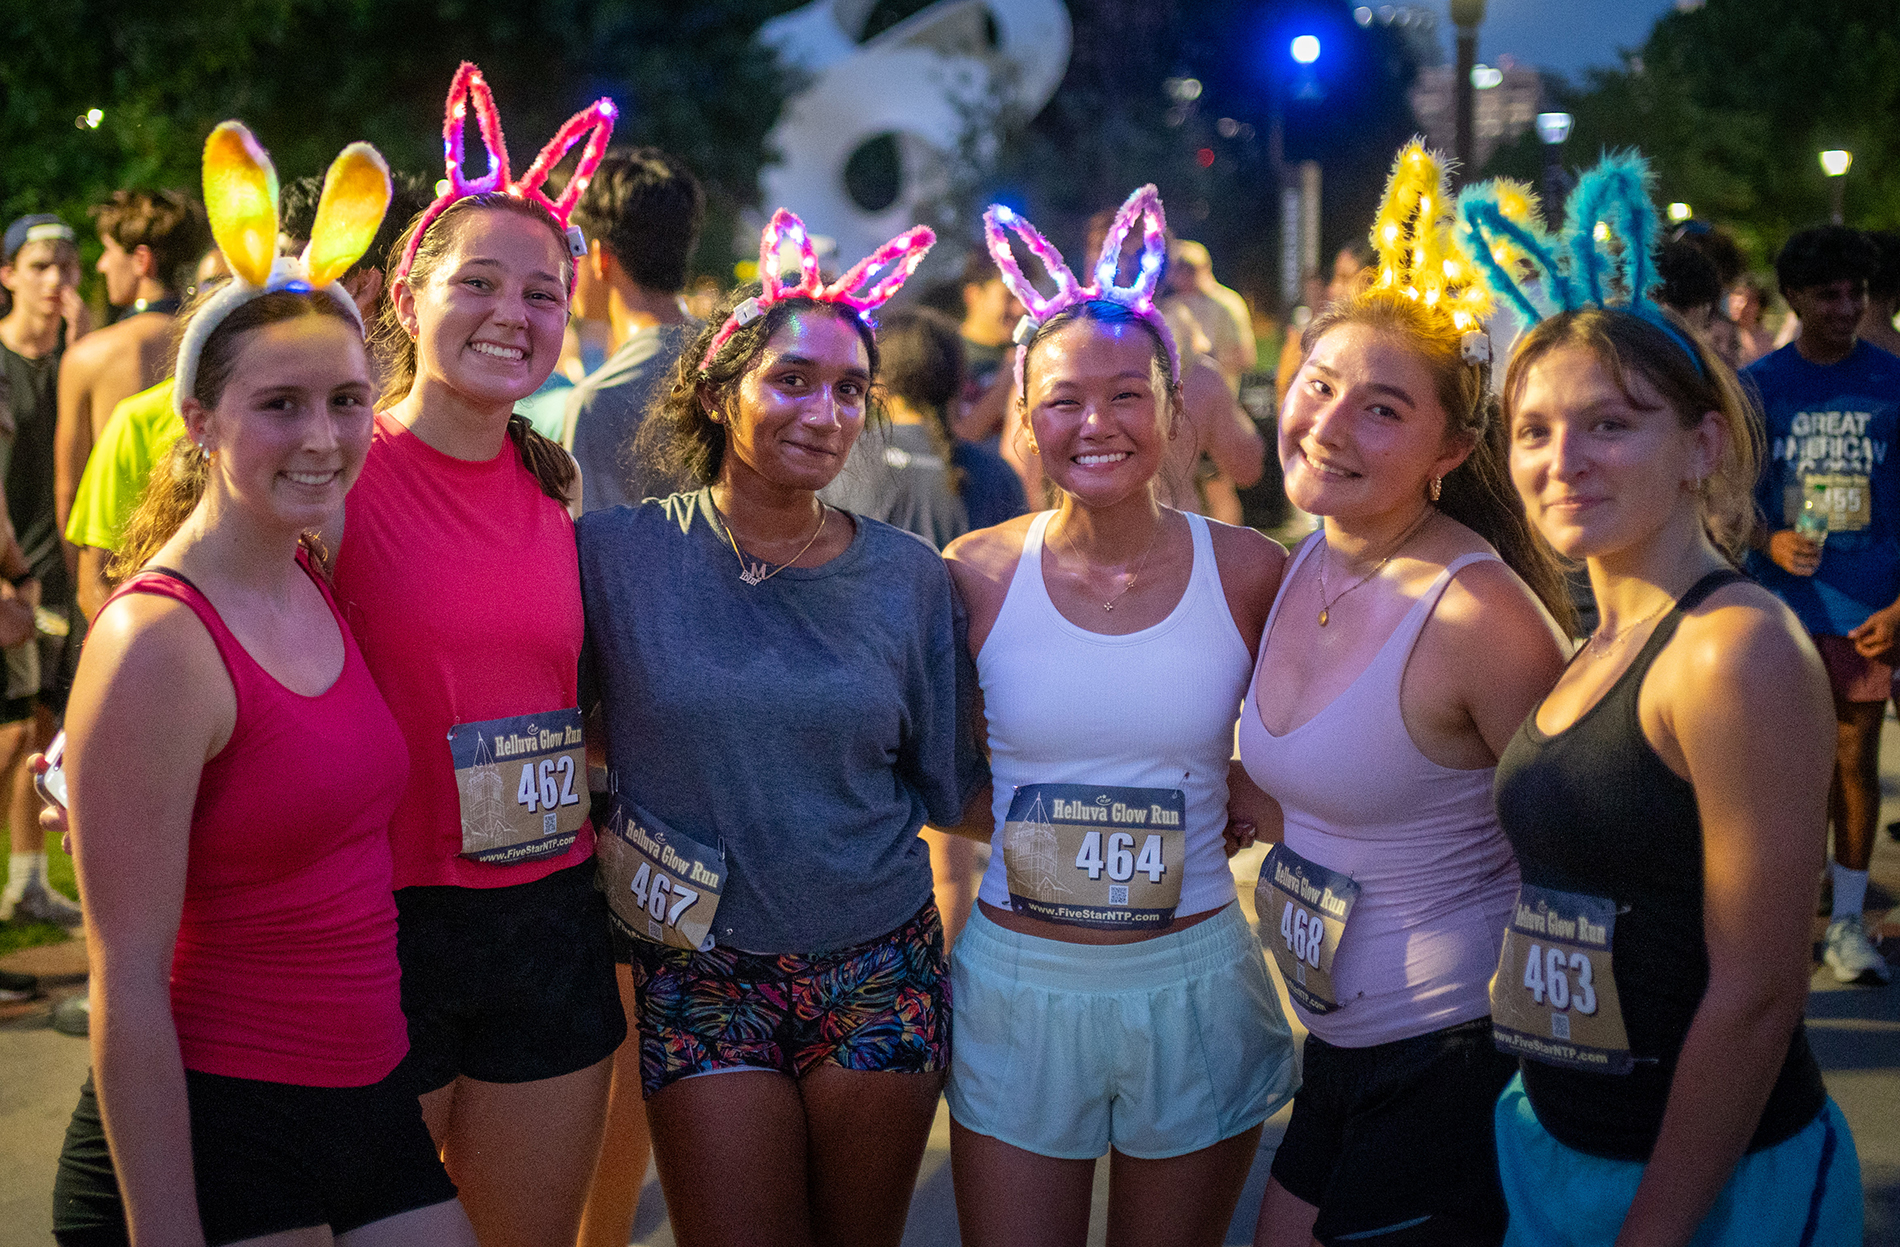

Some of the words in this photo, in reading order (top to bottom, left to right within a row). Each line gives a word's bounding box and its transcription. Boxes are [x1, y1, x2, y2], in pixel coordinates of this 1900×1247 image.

[1792, 411, 1871, 436] GREAT
[495, 734, 538, 757] Helluva
[540, 729, 564, 750] Glow
[564, 725, 582, 745] Run
[517, 755, 580, 813] 462
[1053, 799, 1108, 822] Helluva
[1112, 803, 1148, 824] Glow
[1151, 805, 1180, 825] Run
[479, 835, 576, 862] www.FiveStarNTP.com
[626, 819, 661, 859] Helluva
[661, 844, 691, 875] Glow
[690, 861, 720, 888] Run
[1075, 831, 1166, 884] 464
[631, 861, 699, 929] 467
[1028, 902, 1160, 922] www.FiveStarNTP.com
[1275, 861, 1300, 893] Helluva
[1300, 877, 1322, 904] Glow
[1320, 887, 1347, 917] Run
[1281, 900, 1324, 970] 468
[1547, 910, 1576, 940] Glow
[1577, 915, 1606, 945] Run
[1524, 944, 1597, 1015] 463
